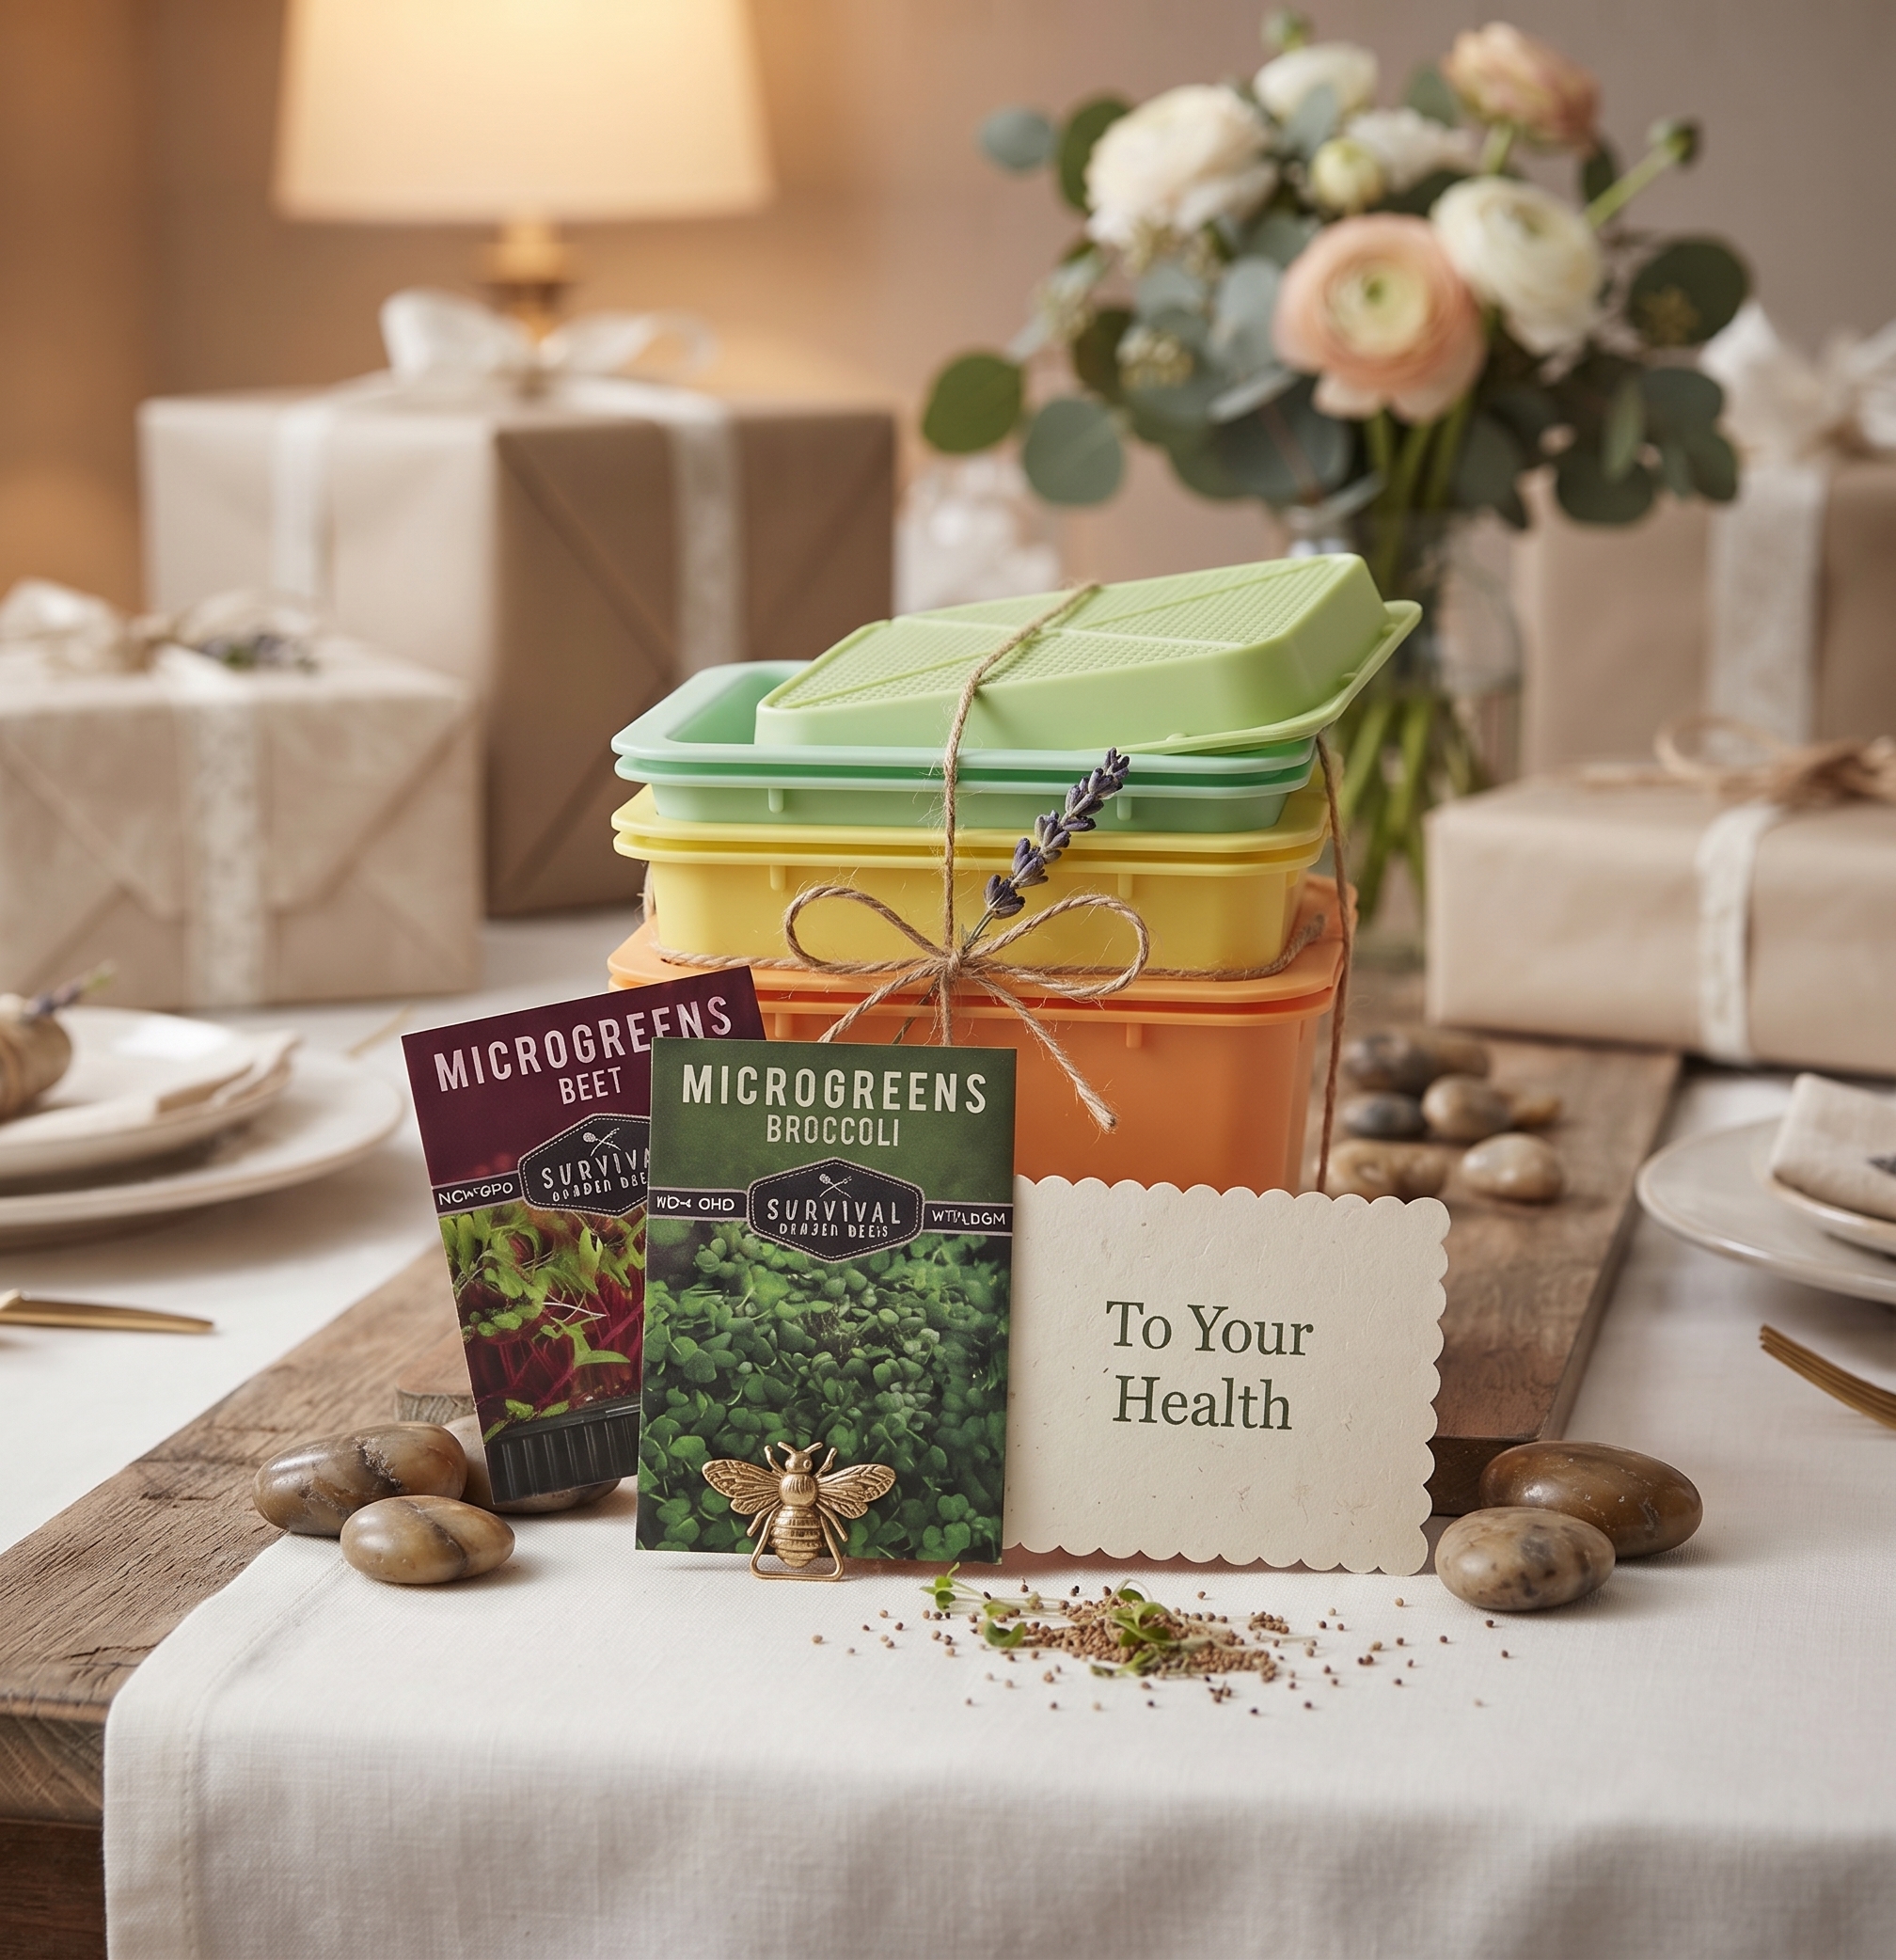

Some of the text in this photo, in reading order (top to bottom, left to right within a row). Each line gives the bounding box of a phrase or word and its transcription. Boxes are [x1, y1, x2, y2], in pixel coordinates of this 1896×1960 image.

[434, 995, 732, 1092] MICROGREENS
[559, 1066, 622, 1105] BEET
[683, 1064, 987, 1114] MICROGREENS
[766, 1114, 899, 1147] BROCCOLI
[766, 1198, 901, 1225] SURVIVAL
[1105, 1300, 1315, 1356] To Your
[1112, 1374, 1293, 1430] Health
